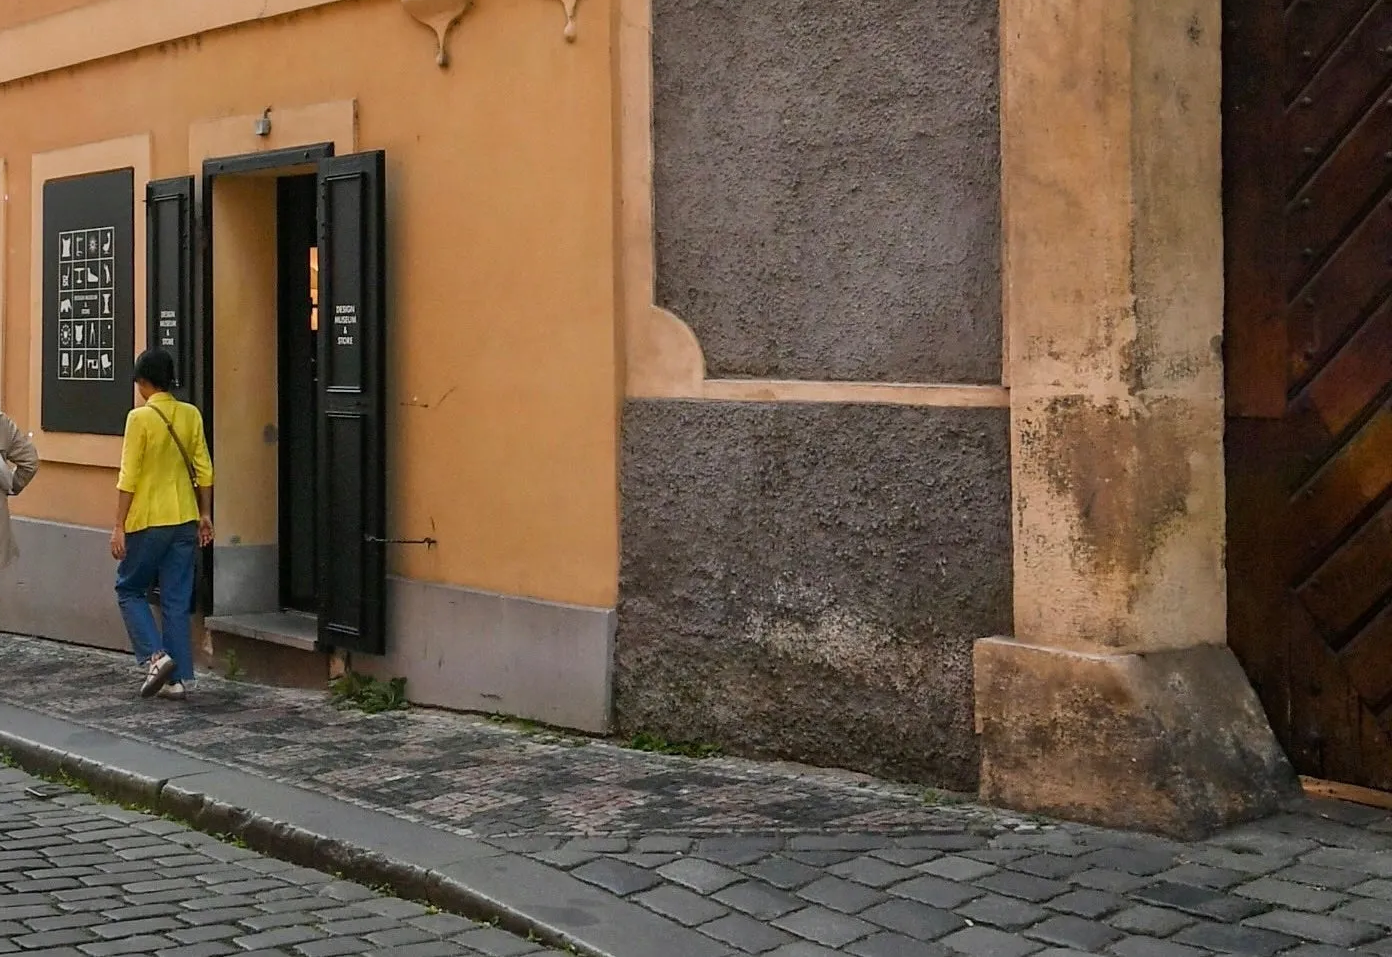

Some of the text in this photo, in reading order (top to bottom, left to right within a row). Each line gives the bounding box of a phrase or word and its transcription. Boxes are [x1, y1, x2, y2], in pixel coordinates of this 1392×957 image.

[336, 305, 355, 313] DESIGN
[335, 315, 356, 323] MUSEUM
[337, 336, 353, 344] STORE
